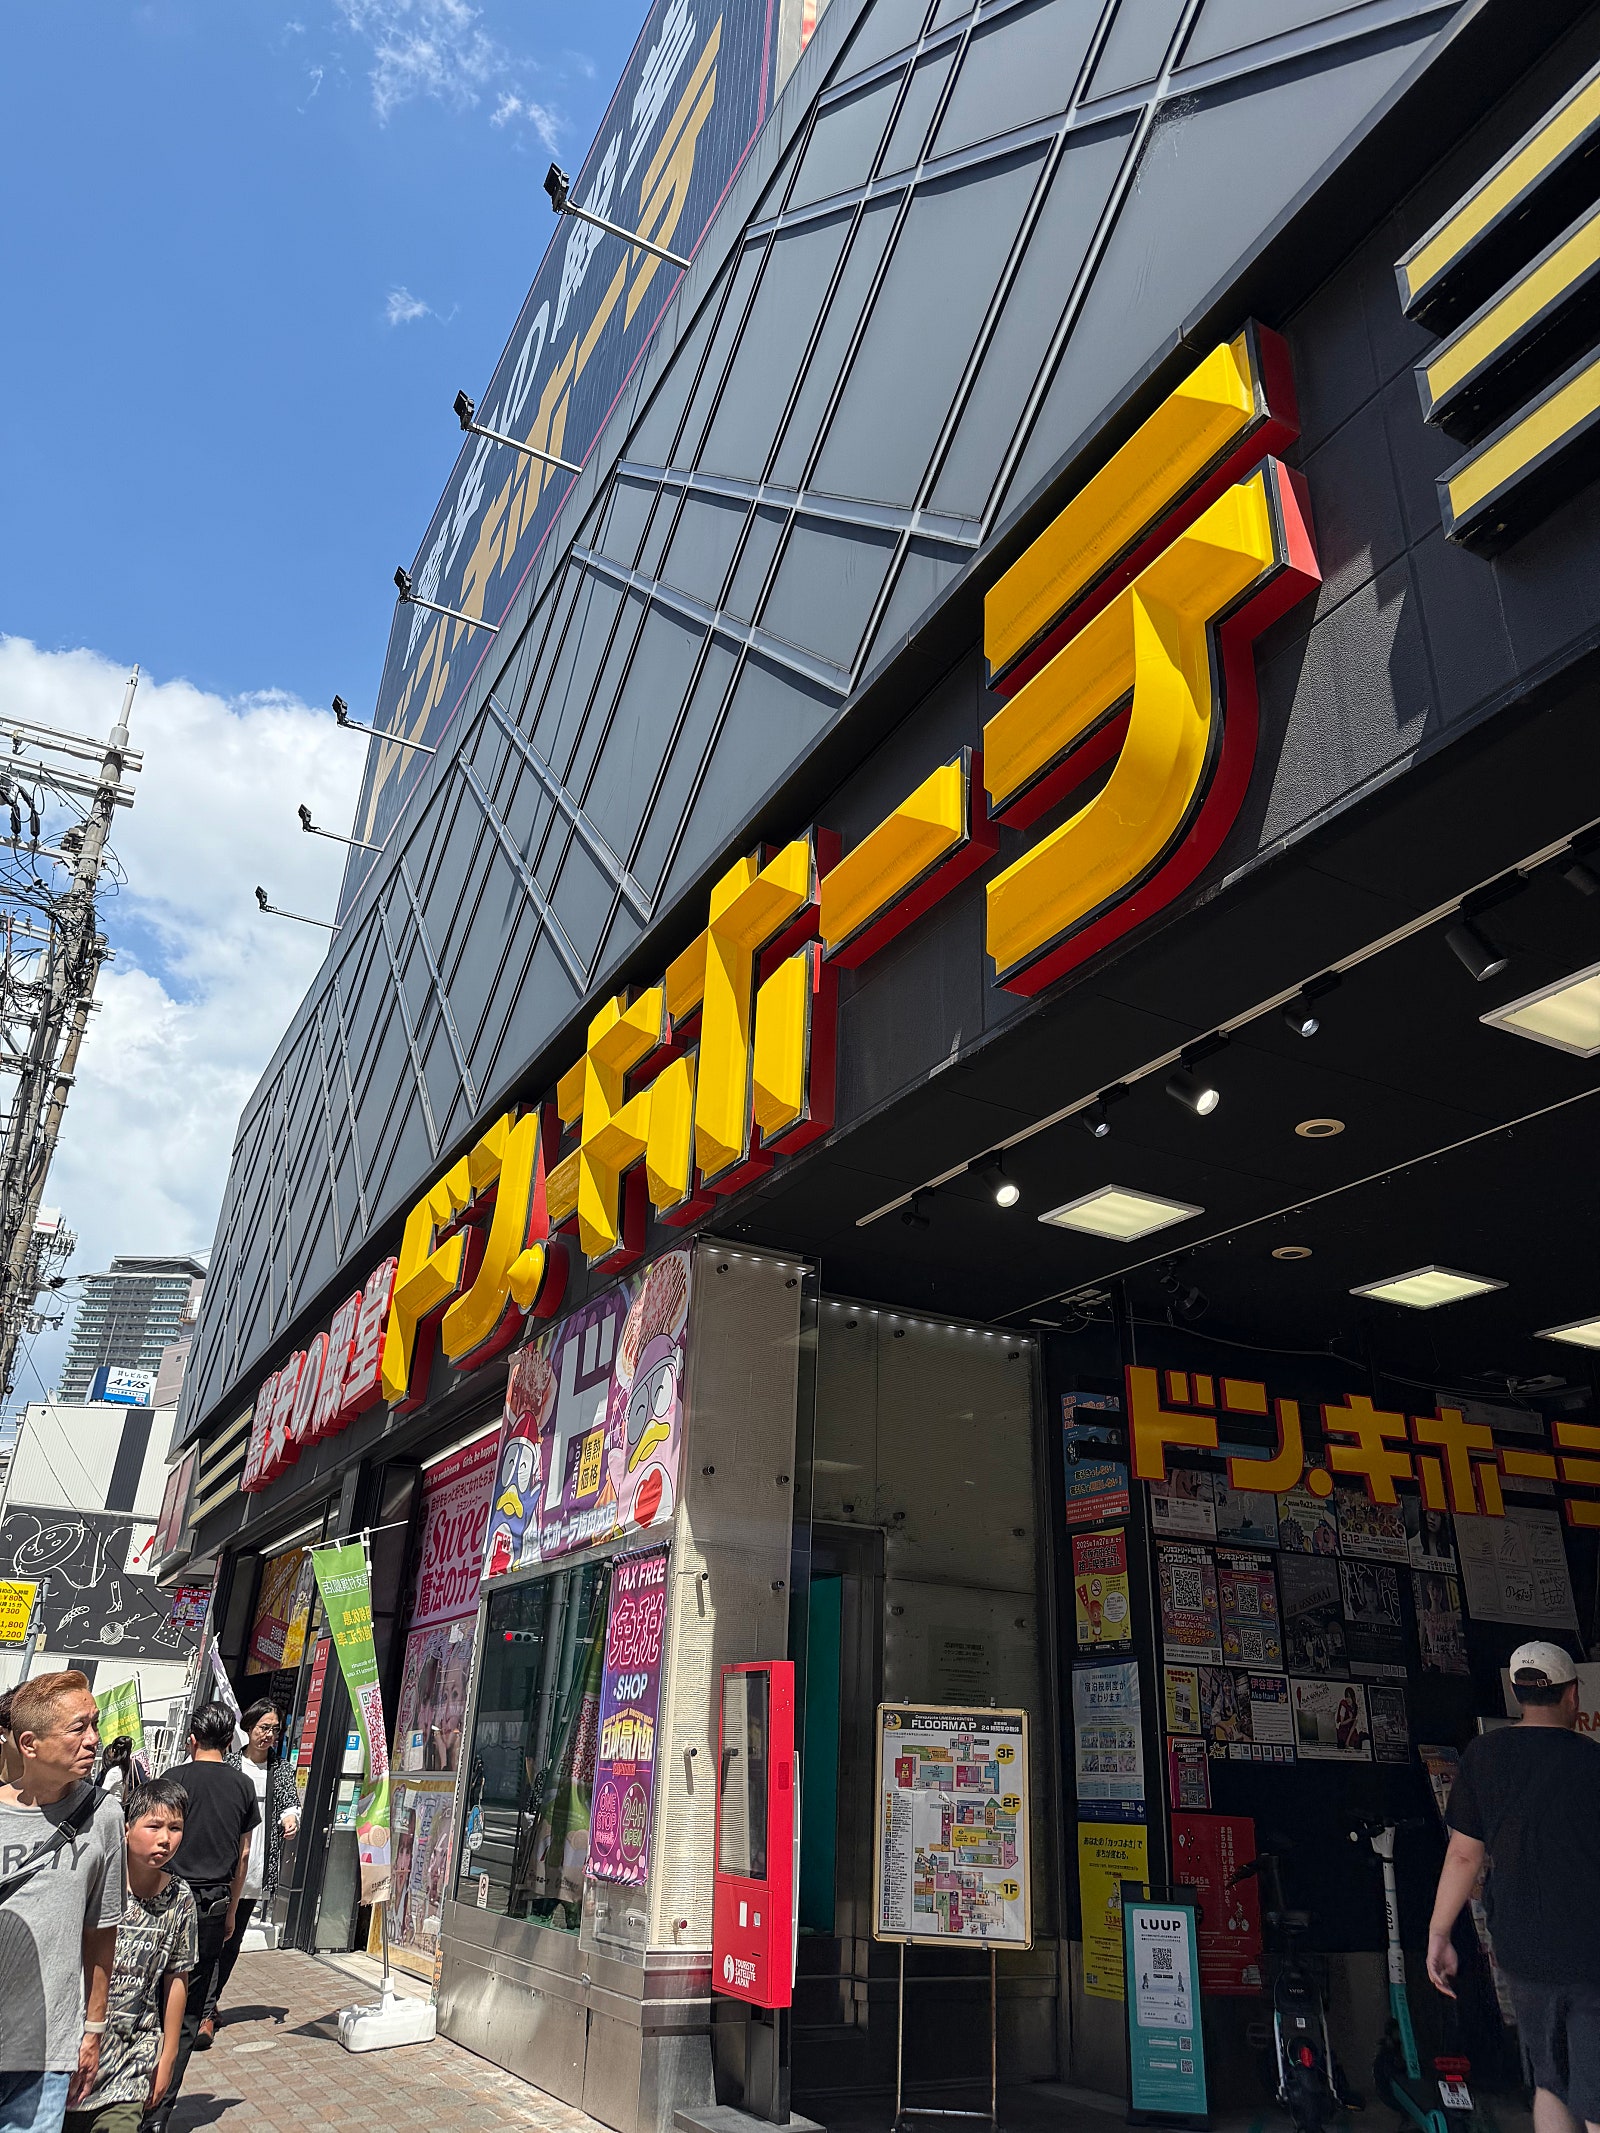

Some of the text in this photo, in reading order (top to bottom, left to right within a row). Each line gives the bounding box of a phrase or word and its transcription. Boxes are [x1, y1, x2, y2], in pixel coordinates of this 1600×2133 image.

[108, 1378, 150, 1389] AXIS
[618, 1558, 666, 1591] TAX FREE
[615, 1673, 648, 1701] SHOP
[911, 1719, 977, 1733] FLOORMAP
[997, 1747, 1015, 1758] 3F
[1003, 1796, 1020, 1808] 2F
[623, 1797, 646, 1829] 24H
[623, 1828, 642, 1847] OPEN
[1003, 1884, 1018, 1895] 1F
[1140, 1918, 1181, 1932] LUUP
